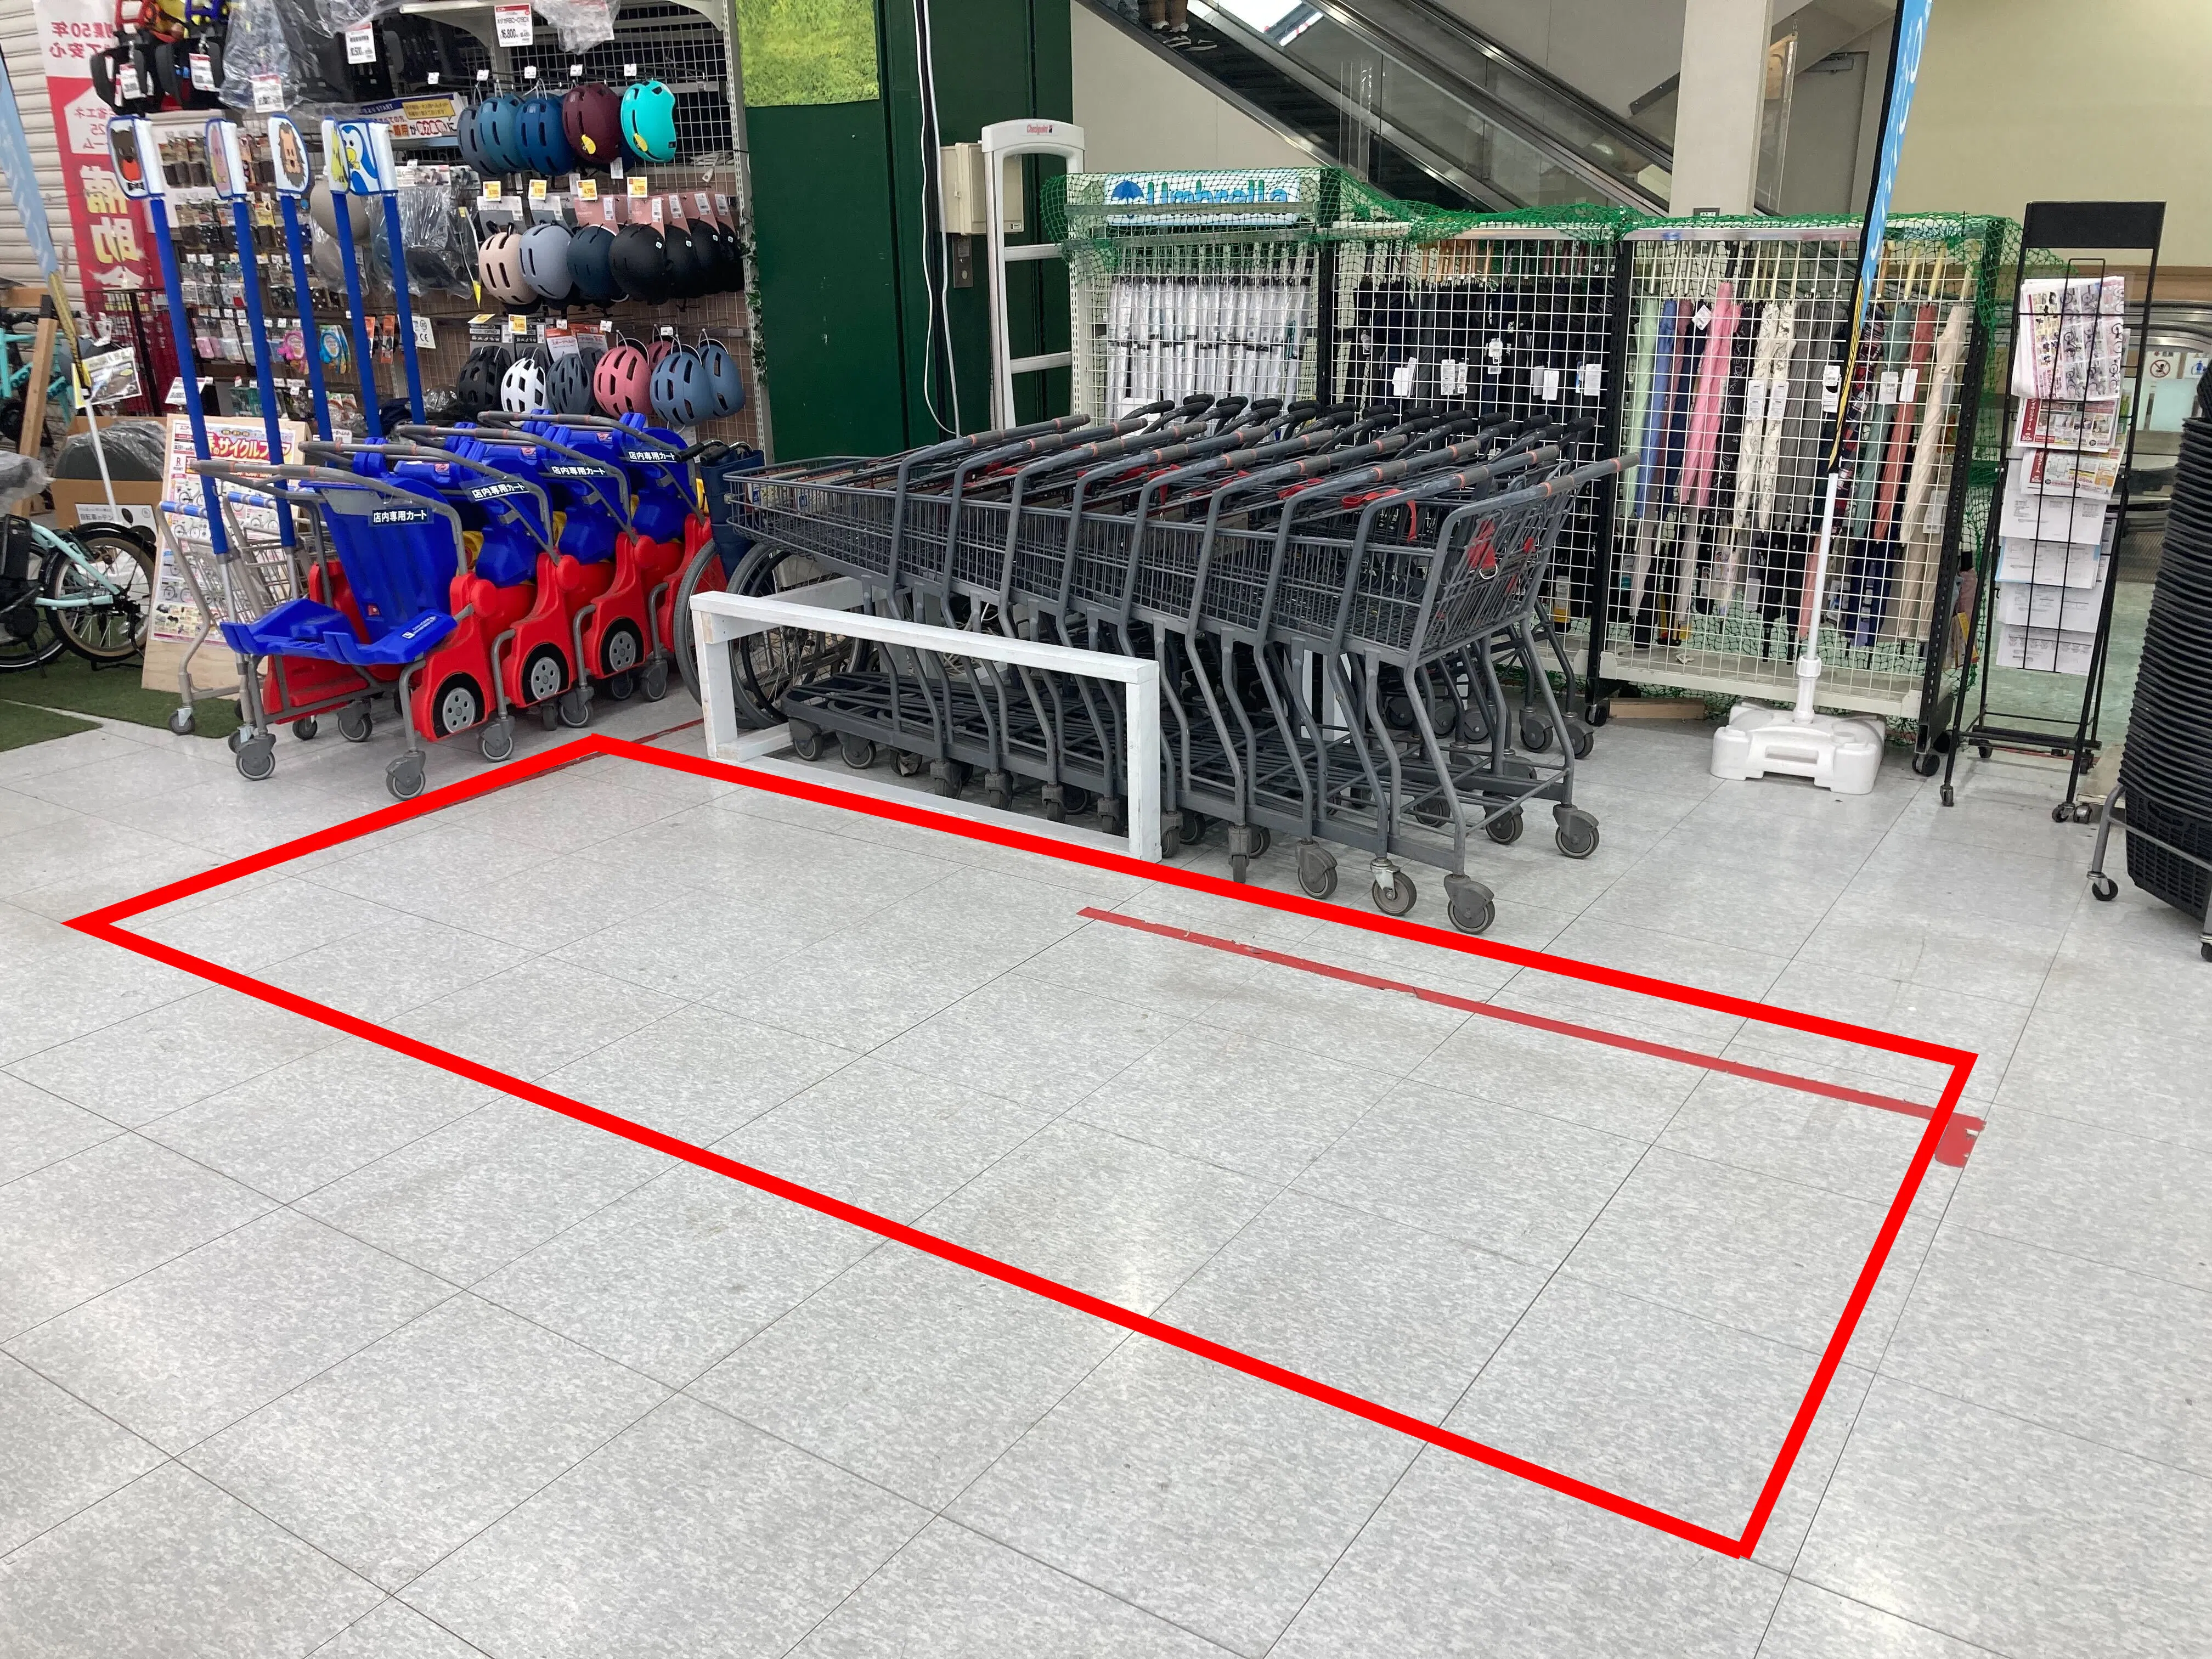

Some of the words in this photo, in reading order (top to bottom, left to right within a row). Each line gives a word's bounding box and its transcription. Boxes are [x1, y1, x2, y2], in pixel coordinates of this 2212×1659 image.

[1147, 179, 1288, 215] Umbrella
[207, 433, 291, 458] のサイクルフア
[628, 451, 675, 460] 店内専用カート
[551, 466, 606, 476] 店内専用カート
[472, 483, 525, 499] 店内専用カート
[373, 510, 427, 523] 店内専用カート
